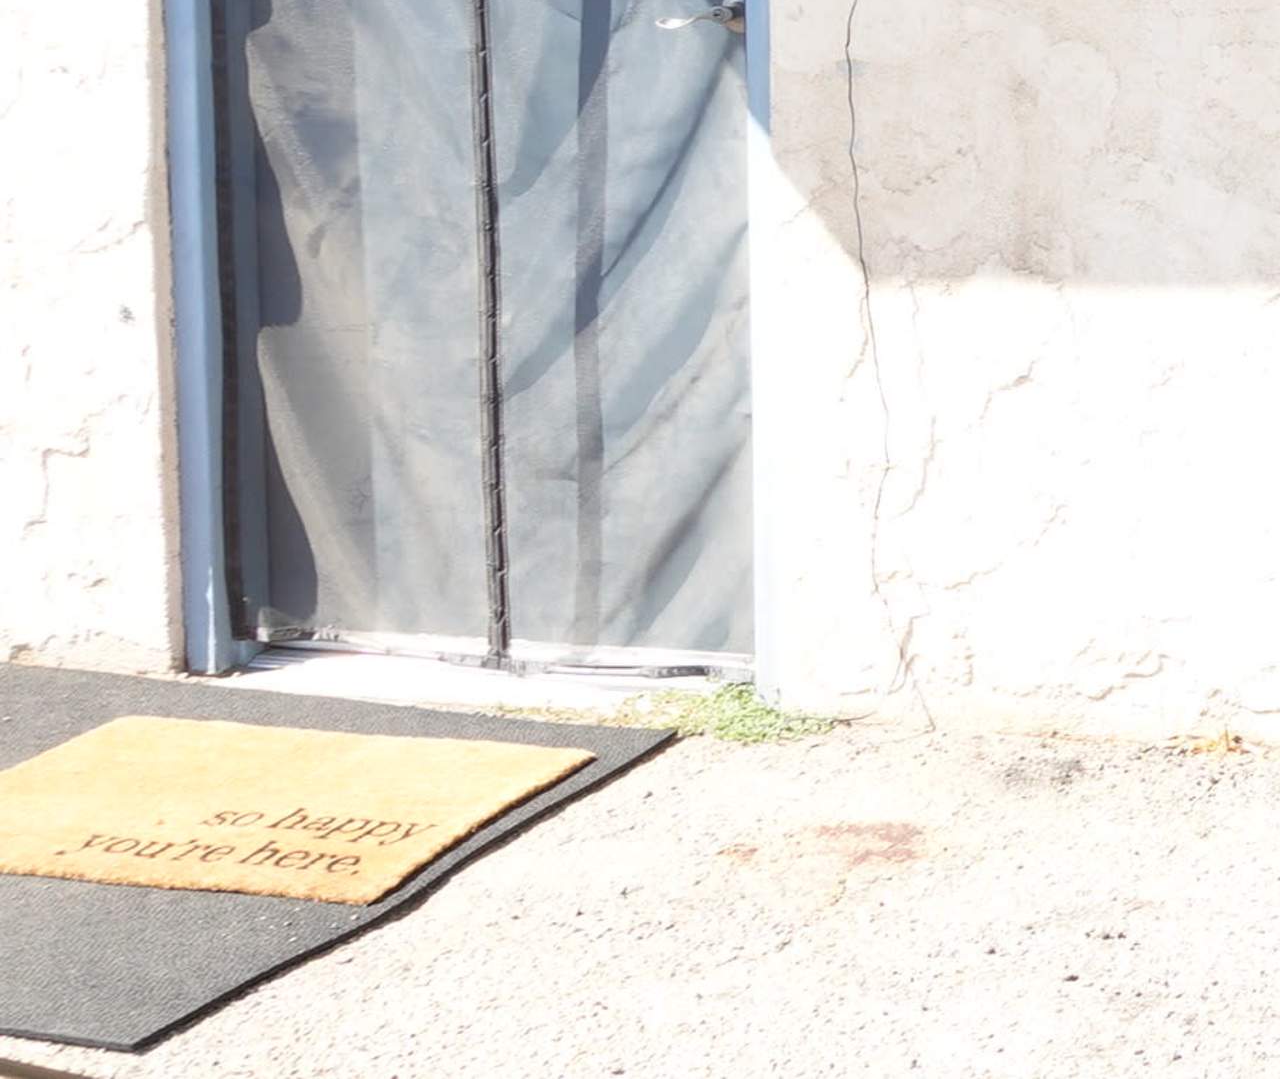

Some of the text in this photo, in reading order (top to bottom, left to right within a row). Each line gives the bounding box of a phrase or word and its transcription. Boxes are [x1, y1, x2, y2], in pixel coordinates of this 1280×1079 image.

[202, 806, 439, 846] so happy
[55, 832, 361, 876] you're here.
